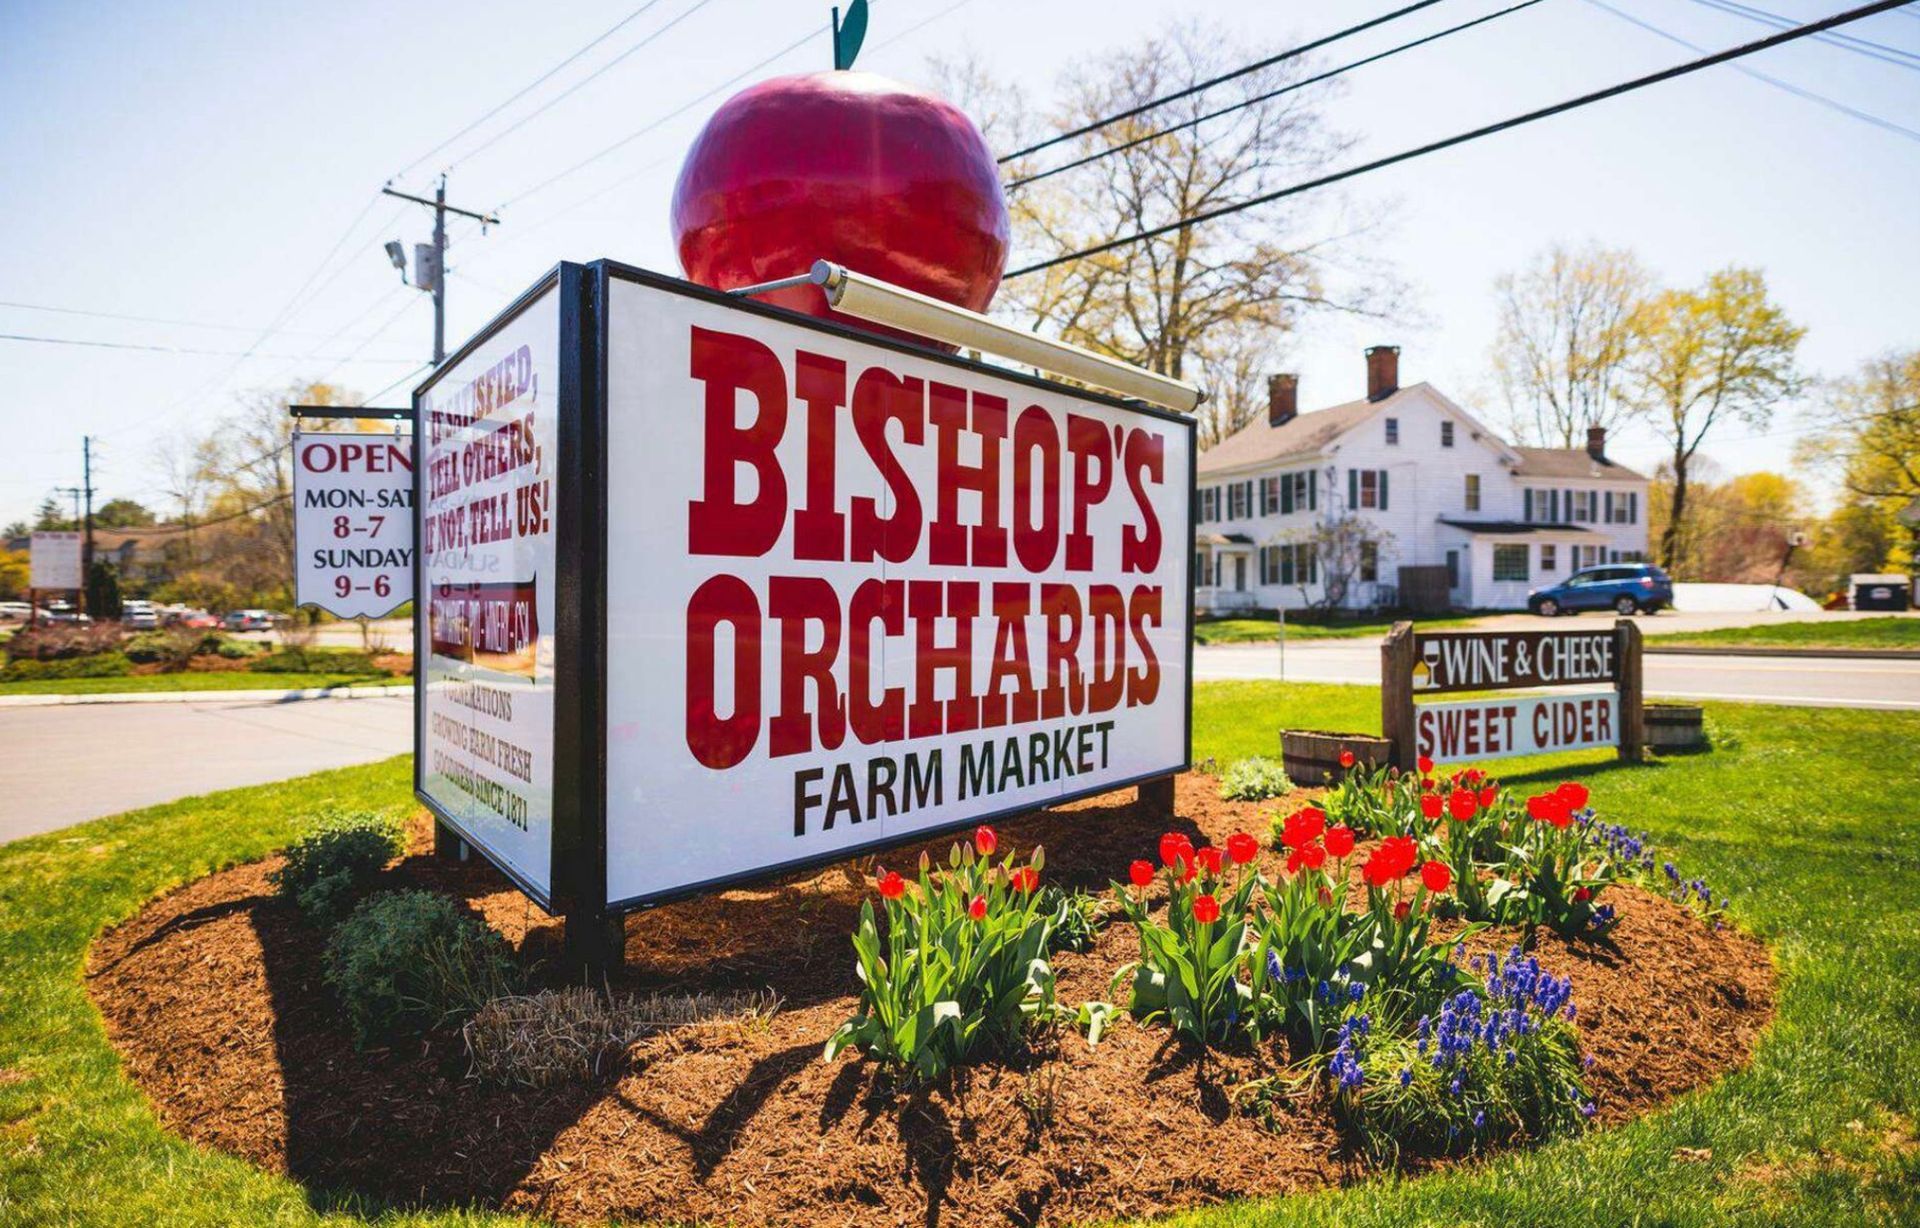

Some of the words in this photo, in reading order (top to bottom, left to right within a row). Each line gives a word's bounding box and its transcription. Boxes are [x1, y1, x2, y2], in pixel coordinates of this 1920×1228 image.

[302, 443, 416, 473] OPEN
[430, 451, 460, 500] TELL
[463, 411, 542, 487] OTHERS,
[688, 325, 1164, 573] BISHOP'S
[425, 516, 436, 554] IF
[438, 505, 468, 559] NOT,
[470, 492, 512, 545] TELL
[516, 480, 549, 537] US!
[314, 549, 415, 569] SUNDAY
[686, 574, 1162, 770] ORCHARDS
[1442, 638, 1509, 685] WINE
[1514, 640, 1532, 676] &
[1537, 635, 1613, 681] CHEESE
[1417, 706, 1517, 758] SWEET
[1533, 699, 1612, 748] CIDER
[498, 739, 532, 784] FRESH
[794, 748, 943, 836] FARM
[958, 721, 1115, 800] MARKET
[476, 773, 504, 816] SINCE
[506, 790, 528, 833] 1871
